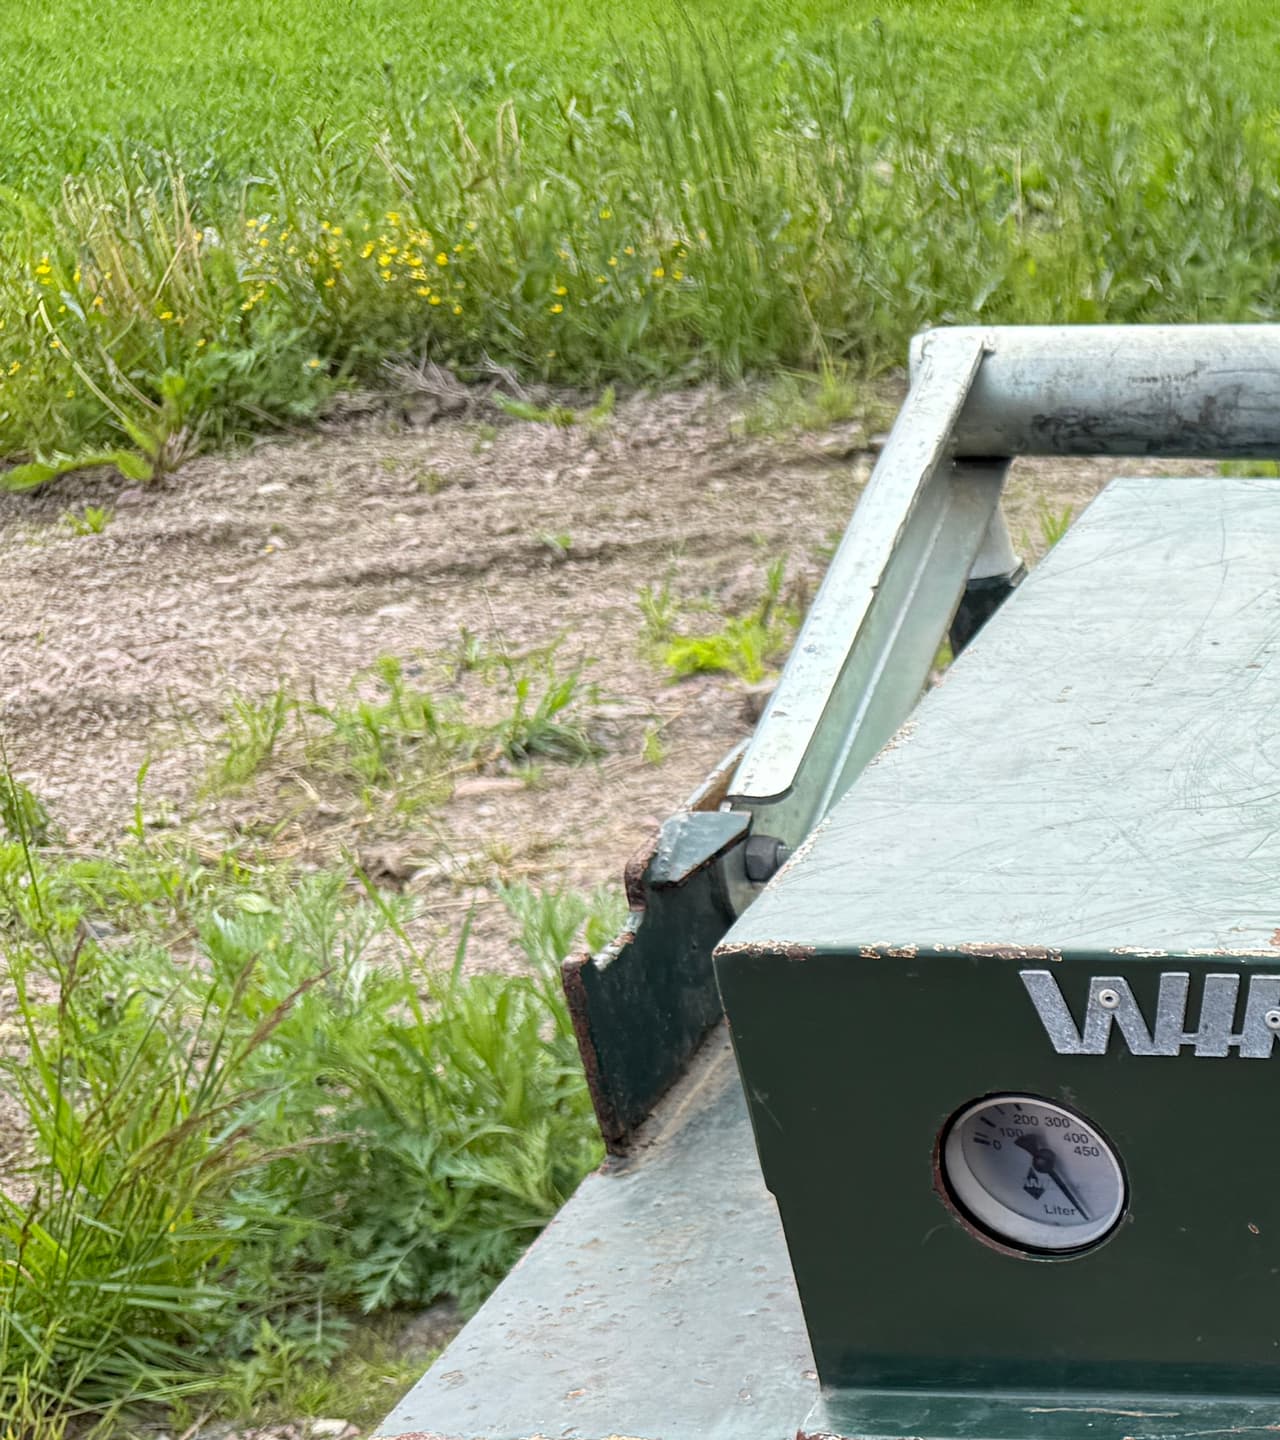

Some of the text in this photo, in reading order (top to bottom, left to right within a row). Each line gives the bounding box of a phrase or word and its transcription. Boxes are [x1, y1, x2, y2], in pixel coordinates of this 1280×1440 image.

[1014, 1114, 1039, 1126] 200
[1045, 1116, 1070, 1128] 300
[1000, 1128, 1024, 1138] 100
[1064, 1133, 1089, 1144] 400
[993, 1140, 1002, 1150] 0
[1074, 1146, 1100, 1157] 450
[1044, 1204, 1076, 1216] Liter
